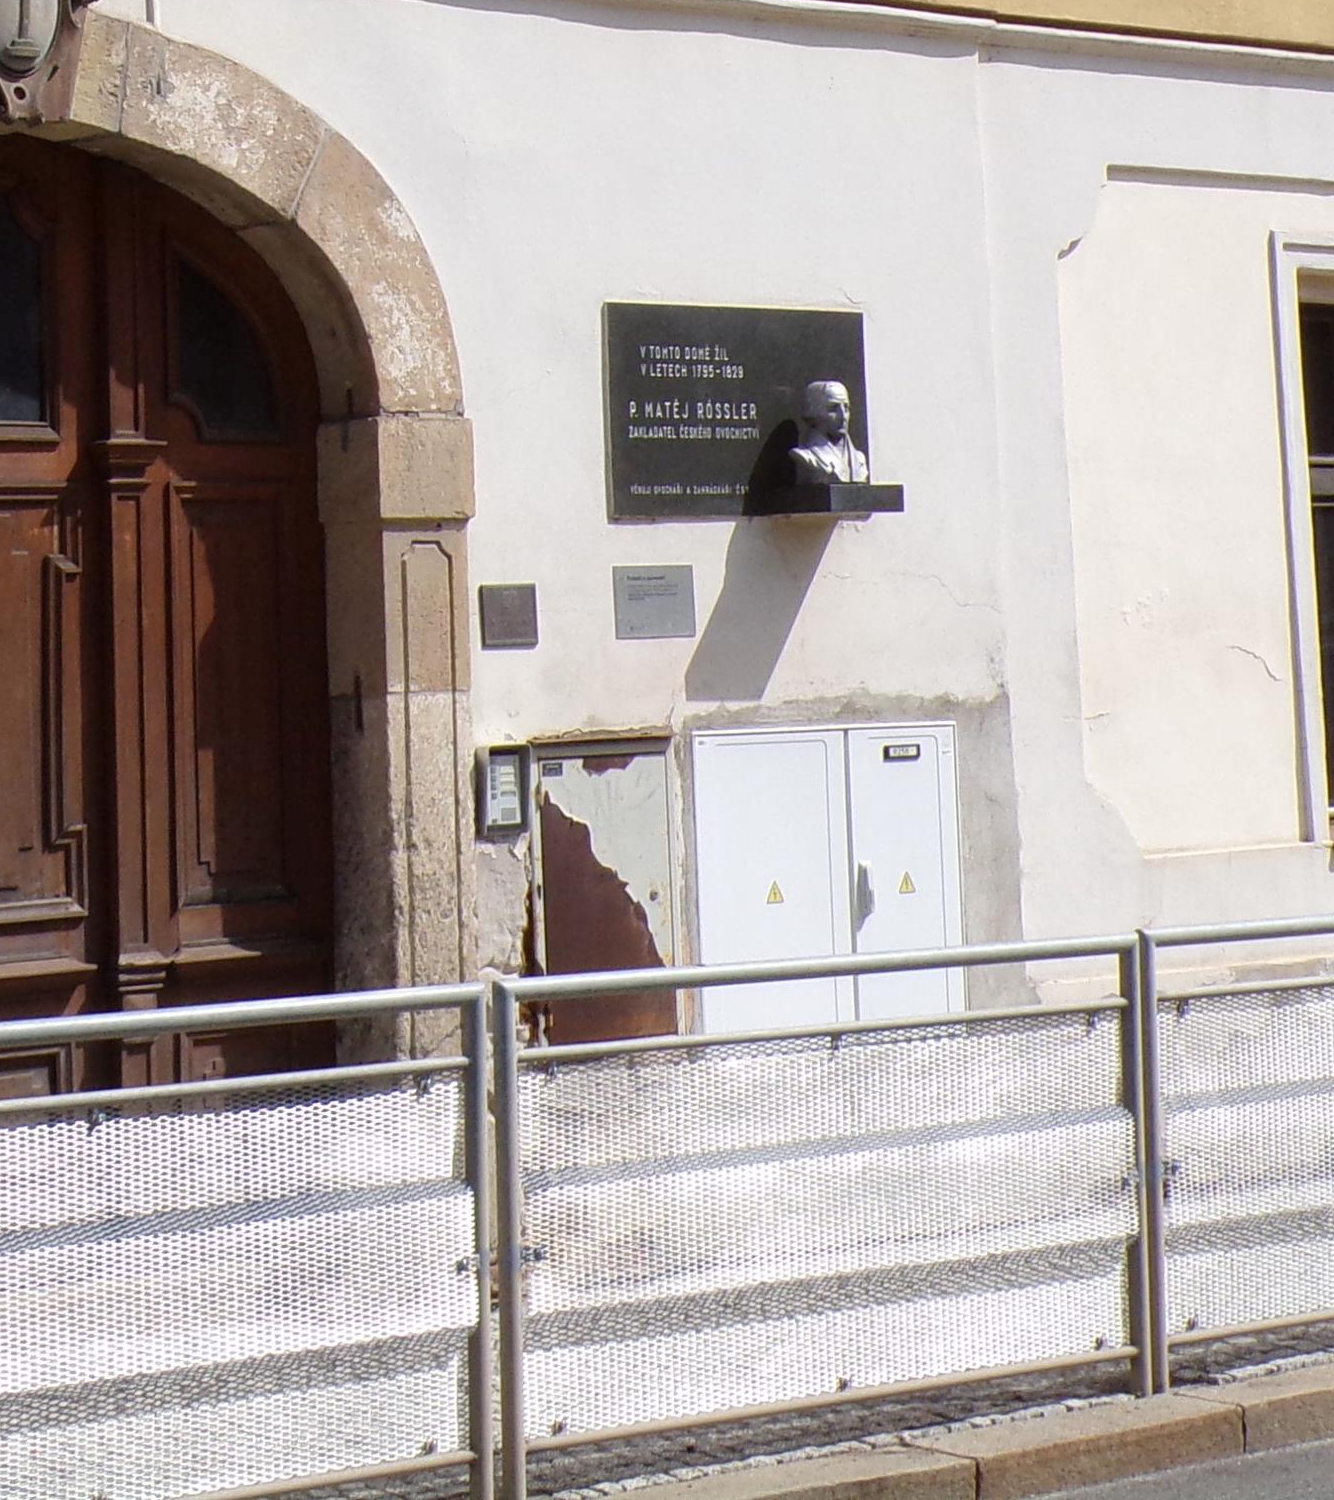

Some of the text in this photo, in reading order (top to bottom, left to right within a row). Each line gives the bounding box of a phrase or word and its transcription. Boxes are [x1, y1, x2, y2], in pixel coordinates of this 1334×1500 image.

[639, 344, 729, 361] V TOMTO DOMĚ ŽIL
[640, 363, 647, 376] V
[650, 363, 688, 378] LETECH
[629, 400, 639, 419] P.
[645, 398, 689, 419] MATĚJ
[628, 425, 677, 439] ZAKLADATEL
